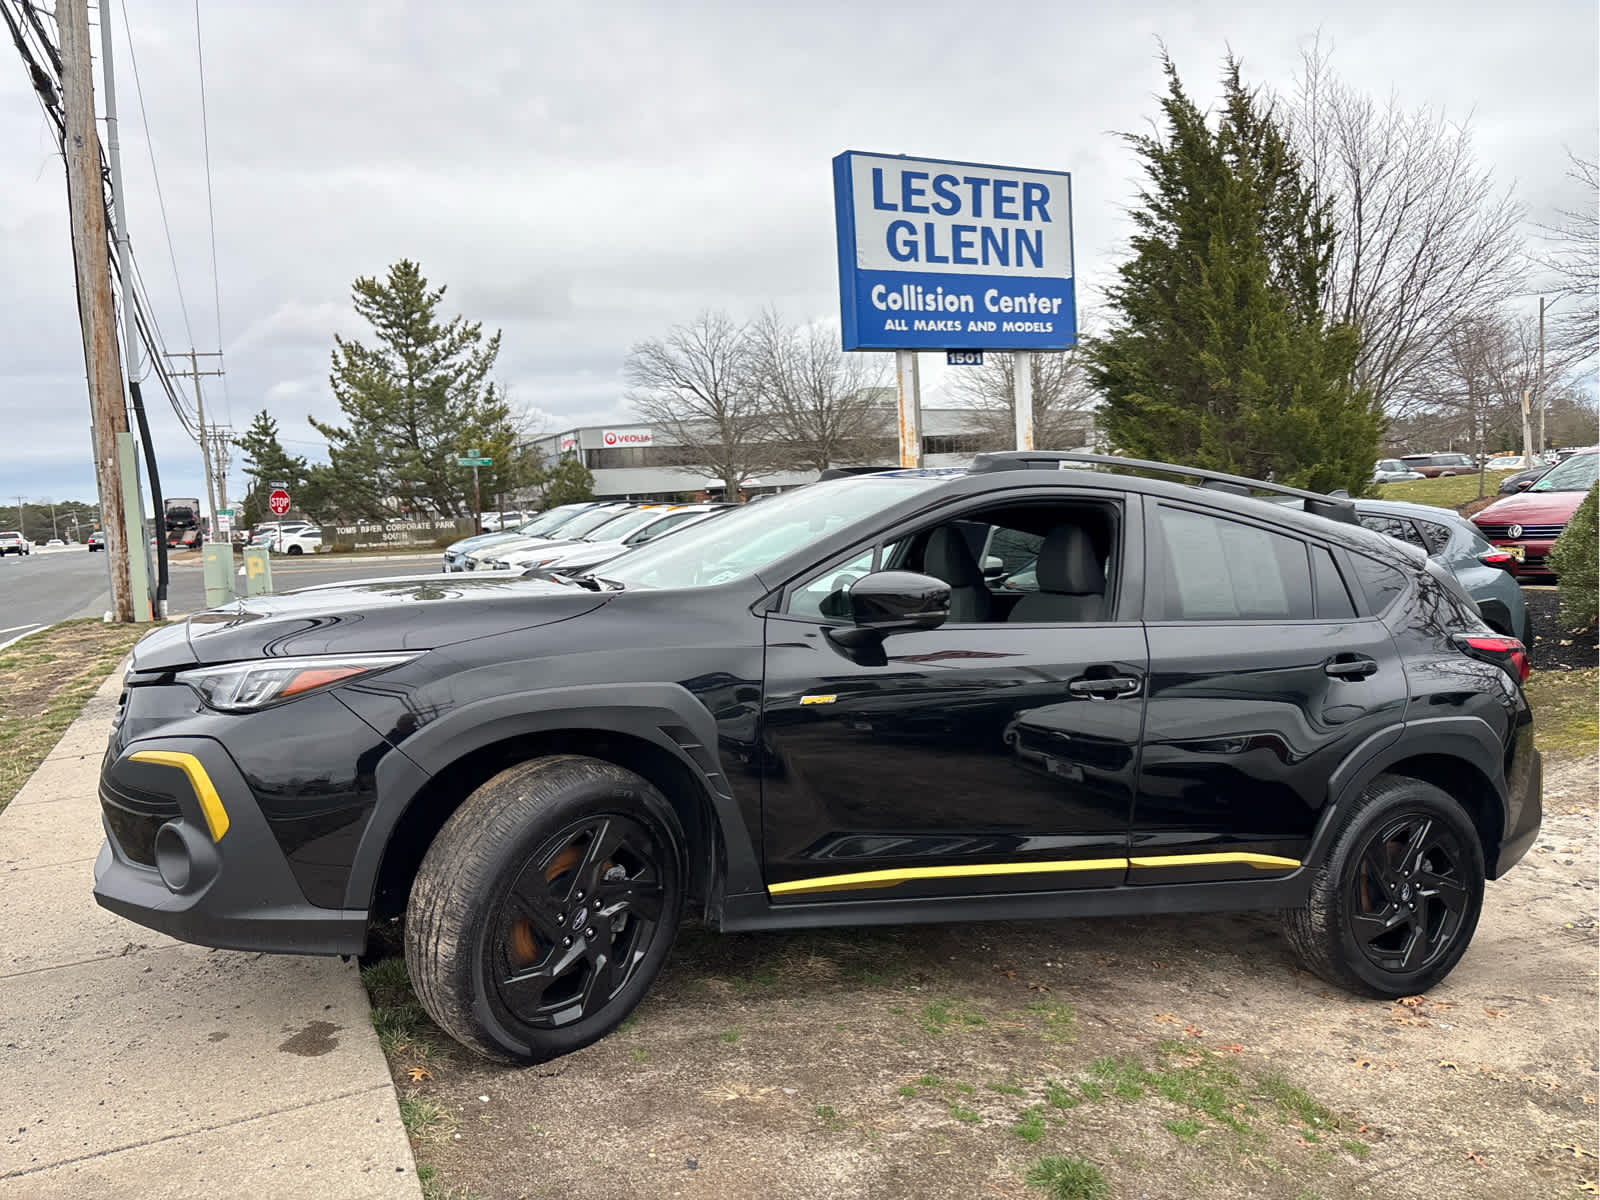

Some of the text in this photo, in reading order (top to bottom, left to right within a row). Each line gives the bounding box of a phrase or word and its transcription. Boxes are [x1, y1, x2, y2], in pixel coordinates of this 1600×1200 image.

[872, 167, 1052, 223] LESTER
[886, 219, 1044, 268] GLENN
[871, 284, 1062, 314] Collision Center
[884, 319, 1053, 333] ALL MAKES AND MODELS
[949, 352, 982, 364] 1501
[617, 434, 650, 443] VEOLIA
[271, 497, 289, 508] STOP
[336, 520, 456, 535] TOMS RIVER CORPORATE PARK
[382, 532, 409, 541] SOUTH
